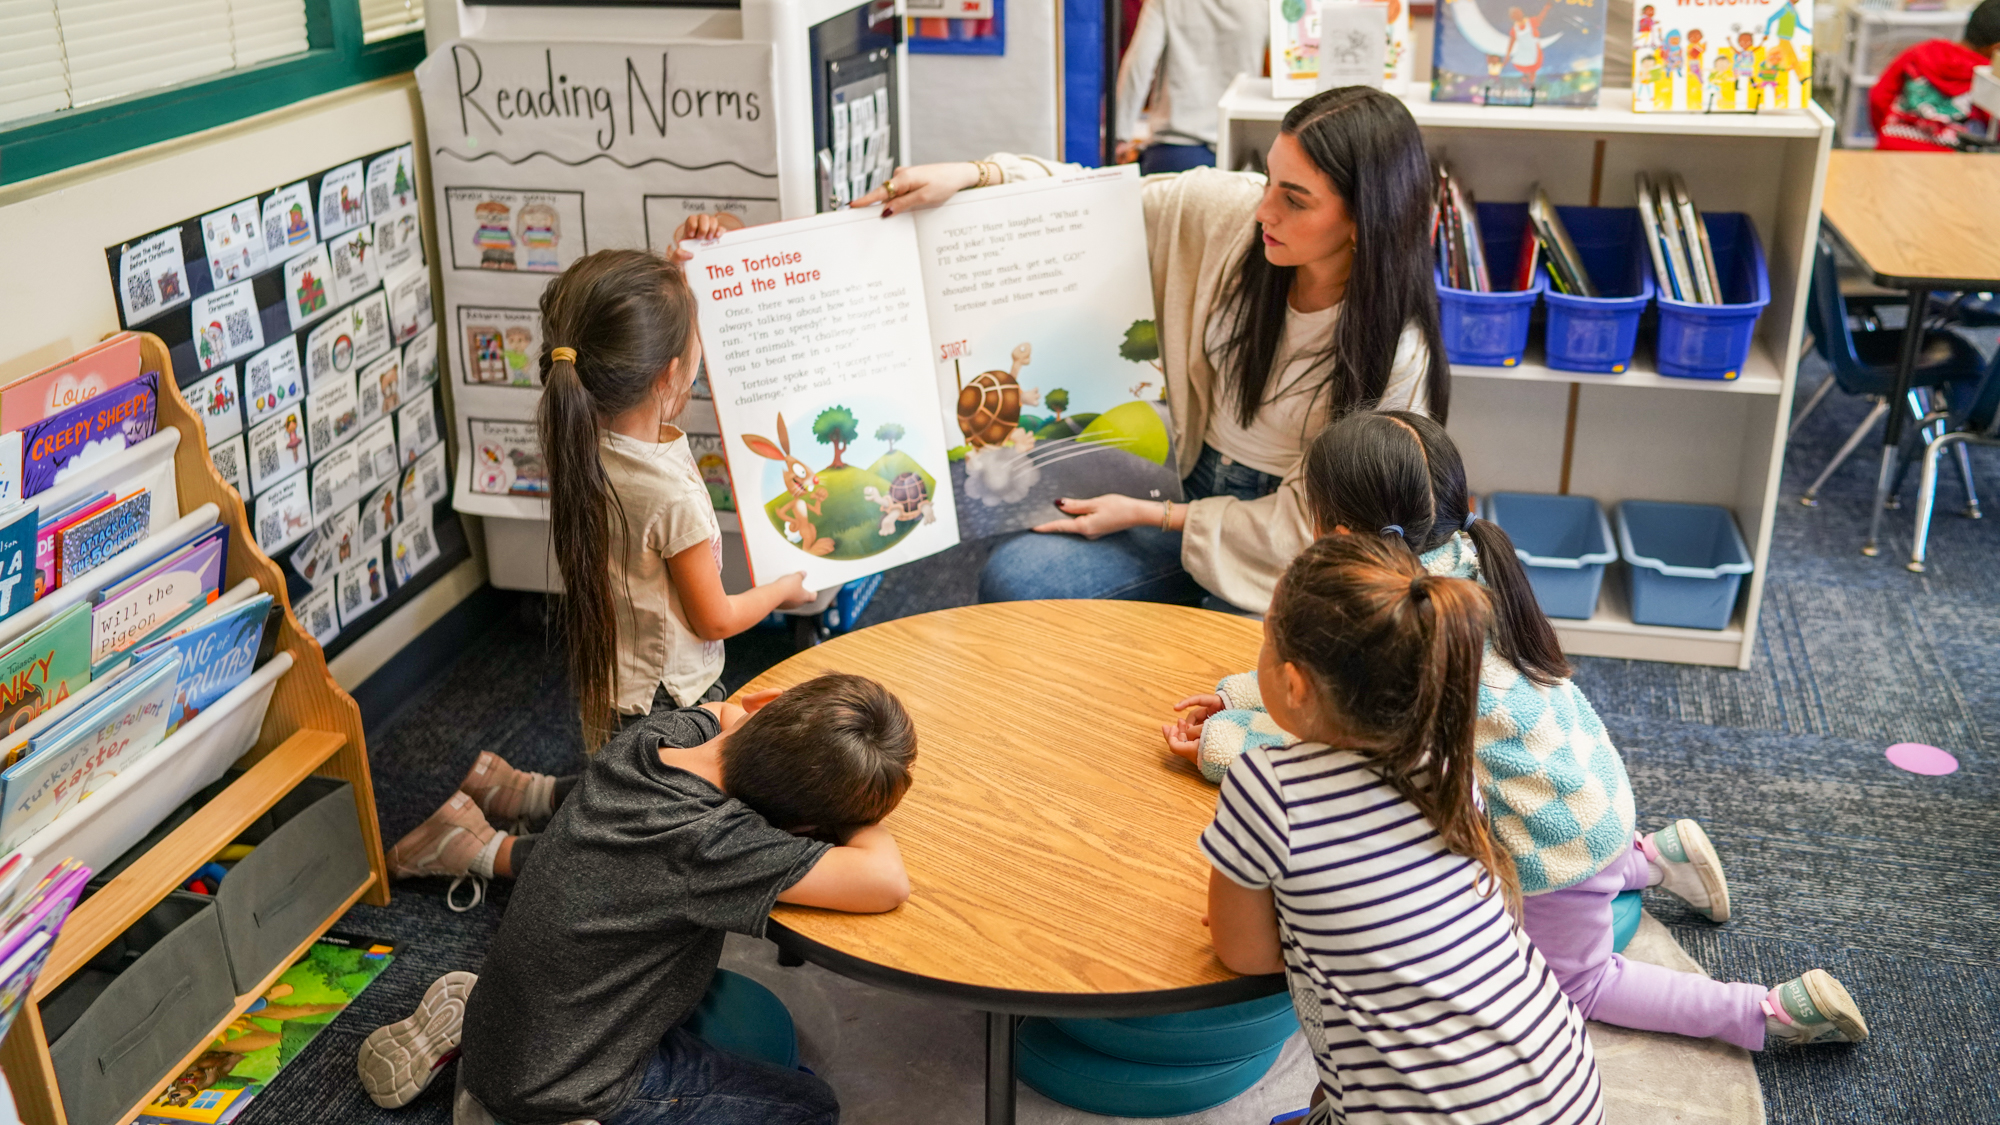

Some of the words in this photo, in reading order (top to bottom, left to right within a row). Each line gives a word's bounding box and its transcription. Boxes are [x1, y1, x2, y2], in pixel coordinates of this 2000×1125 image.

[452, 45, 614, 151] Reading
[626, 52, 761, 138] Norms
[705, 264, 735, 280] The
[741, 251, 802, 273] Tortoise
[712, 281, 744, 301] and
[751, 277, 776, 293] the
[784, 269, 821, 286] Hare
[757, 299, 783, 311] there
[787, 295, 806, 305] was
[820, 288, 840, 299] hare
[718, 320, 753, 334] always
[757, 312, 792, 326] talking
[796, 305, 822, 318] about
[827, 301, 845, 312] how
[773, 328, 784, 337] so
[725, 348, 751, 361] other
[727, 364, 747, 378] you
[750, 360, 762, 370] to
[765, 355, 787, 367] beat
[791, 351, 806, 361] me
[810, 348, 820, 357] in
[940, 339, 968, 360] START
[741, 376, 779, 391] Tortoise
[783, 369, 809, 383] spoke
[793, 383, 808, 394] she
[52, 383, 97, 408] Love
[31, 416, 94, 461] CREEPY
[97, 389, 151, 432] SHEEPY
[36, 534, 55, 557] DE
[80, 521, 119, 555] ATTACK
[119, 512, 132, 529] OF
[71, 555, 91, 576] THE
[101, 602, 139, 633] Will
[148, 583, 174, 606] the
[100, 612, 156, 654] Pigeon
[171, 634, 257, 714] FRUTAS
[18, 743, 91, 812] Turkey's
[96, 699, 165, 745] Eggcellent
[53, 738, 130, 805] Easter
